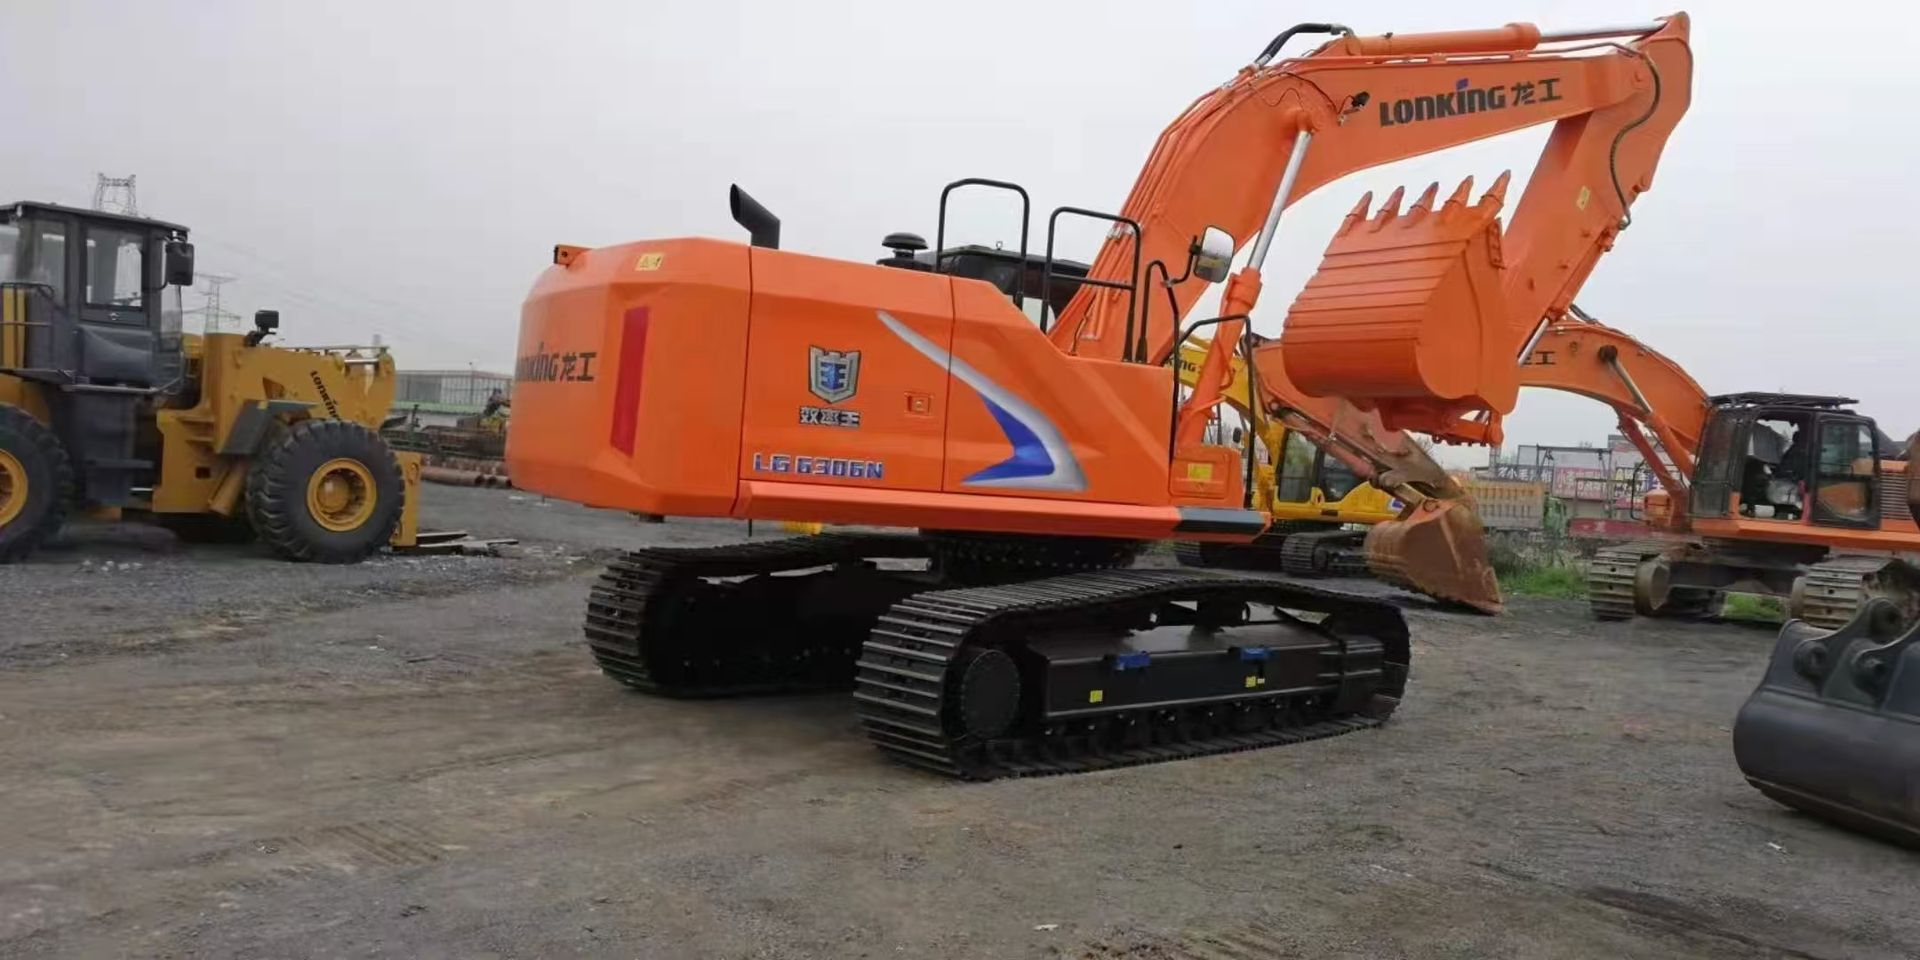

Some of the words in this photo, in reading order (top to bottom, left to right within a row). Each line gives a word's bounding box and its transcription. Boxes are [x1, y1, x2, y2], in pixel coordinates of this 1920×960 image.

[1511, 78, 1562, 107] 龙工
[561, 351, 597, 382] 龙工
[753, 451, 791, 474] LG
